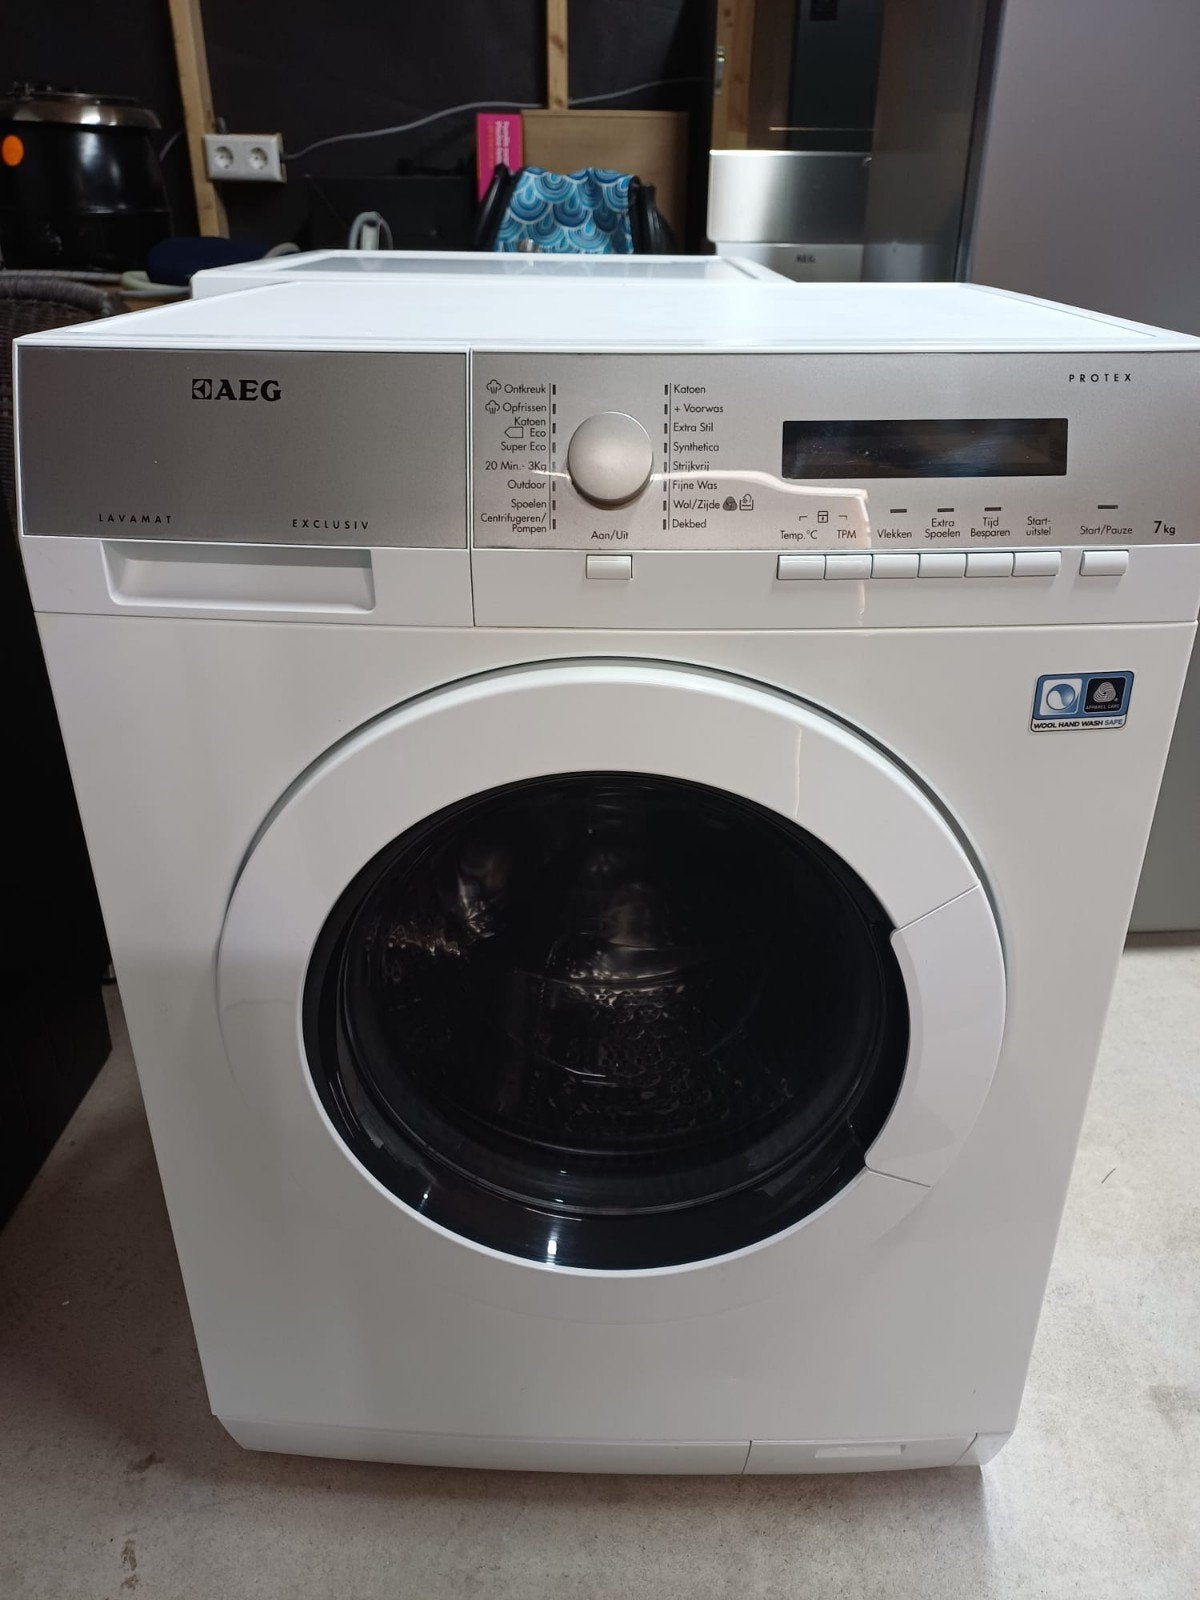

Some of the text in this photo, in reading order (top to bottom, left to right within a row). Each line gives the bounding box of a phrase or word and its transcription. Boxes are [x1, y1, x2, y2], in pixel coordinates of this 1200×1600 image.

[1068, 373, 1131, 382] PROTEX
[214, 379, 282, 401] AEG
[504, 383, 546, 394] Ontkreuk
[673, 383, 706, 394] Katoen
[502, 402, 547, 414] Opfrissen
[683, 403, 724, 413] Voorwas
[514, 416, 546, 426] Katoen
[529, 427, 547, 438] Eco
[673, 422, 714, 432] Extra Stil
[500, 441, 547, 454] Super Eco
[673, 441, 720, 454] Synthetica
[485, 460, 498, 471] 20
[528, 460, 547, 472] 3Kg
[673, 460, 710, 472] Strijkvrij
[507, 479, 546, 489] Outdoor
[672, 480, 718, 492] Fijne Was
[511, 498, 547, 511] Spoelen
[673, 498, 720, 512] Wol/Zijde
[98, 513, 172, 524] LAVAMAT
[292, 518, 369, 530] EXCLUSIV
[480, 512, 547, 525] Centrifugeren/
[672, 518, 707, 529] Dekbed
[931, 517, 955, 527] Extra
[982, 516, 1000, 529] Tijd
[1027, 515, 1052, 526] Start-
[512, 524, 547, 535] Pompen
[590, 529, 629, 541] Aan/Uit
[837, 529, 857, 539] TPM
[877, 528, 913, 539] Vlekken
[924, 529, 961, 540] Spoelen
[970, 527, 1011, 539] Besparen
[1025, 526, 1052, 536] uitstel
[1080, 525, 1133, 536] Start/Pauze
[1104, 718, 1123, 726] SAFE
